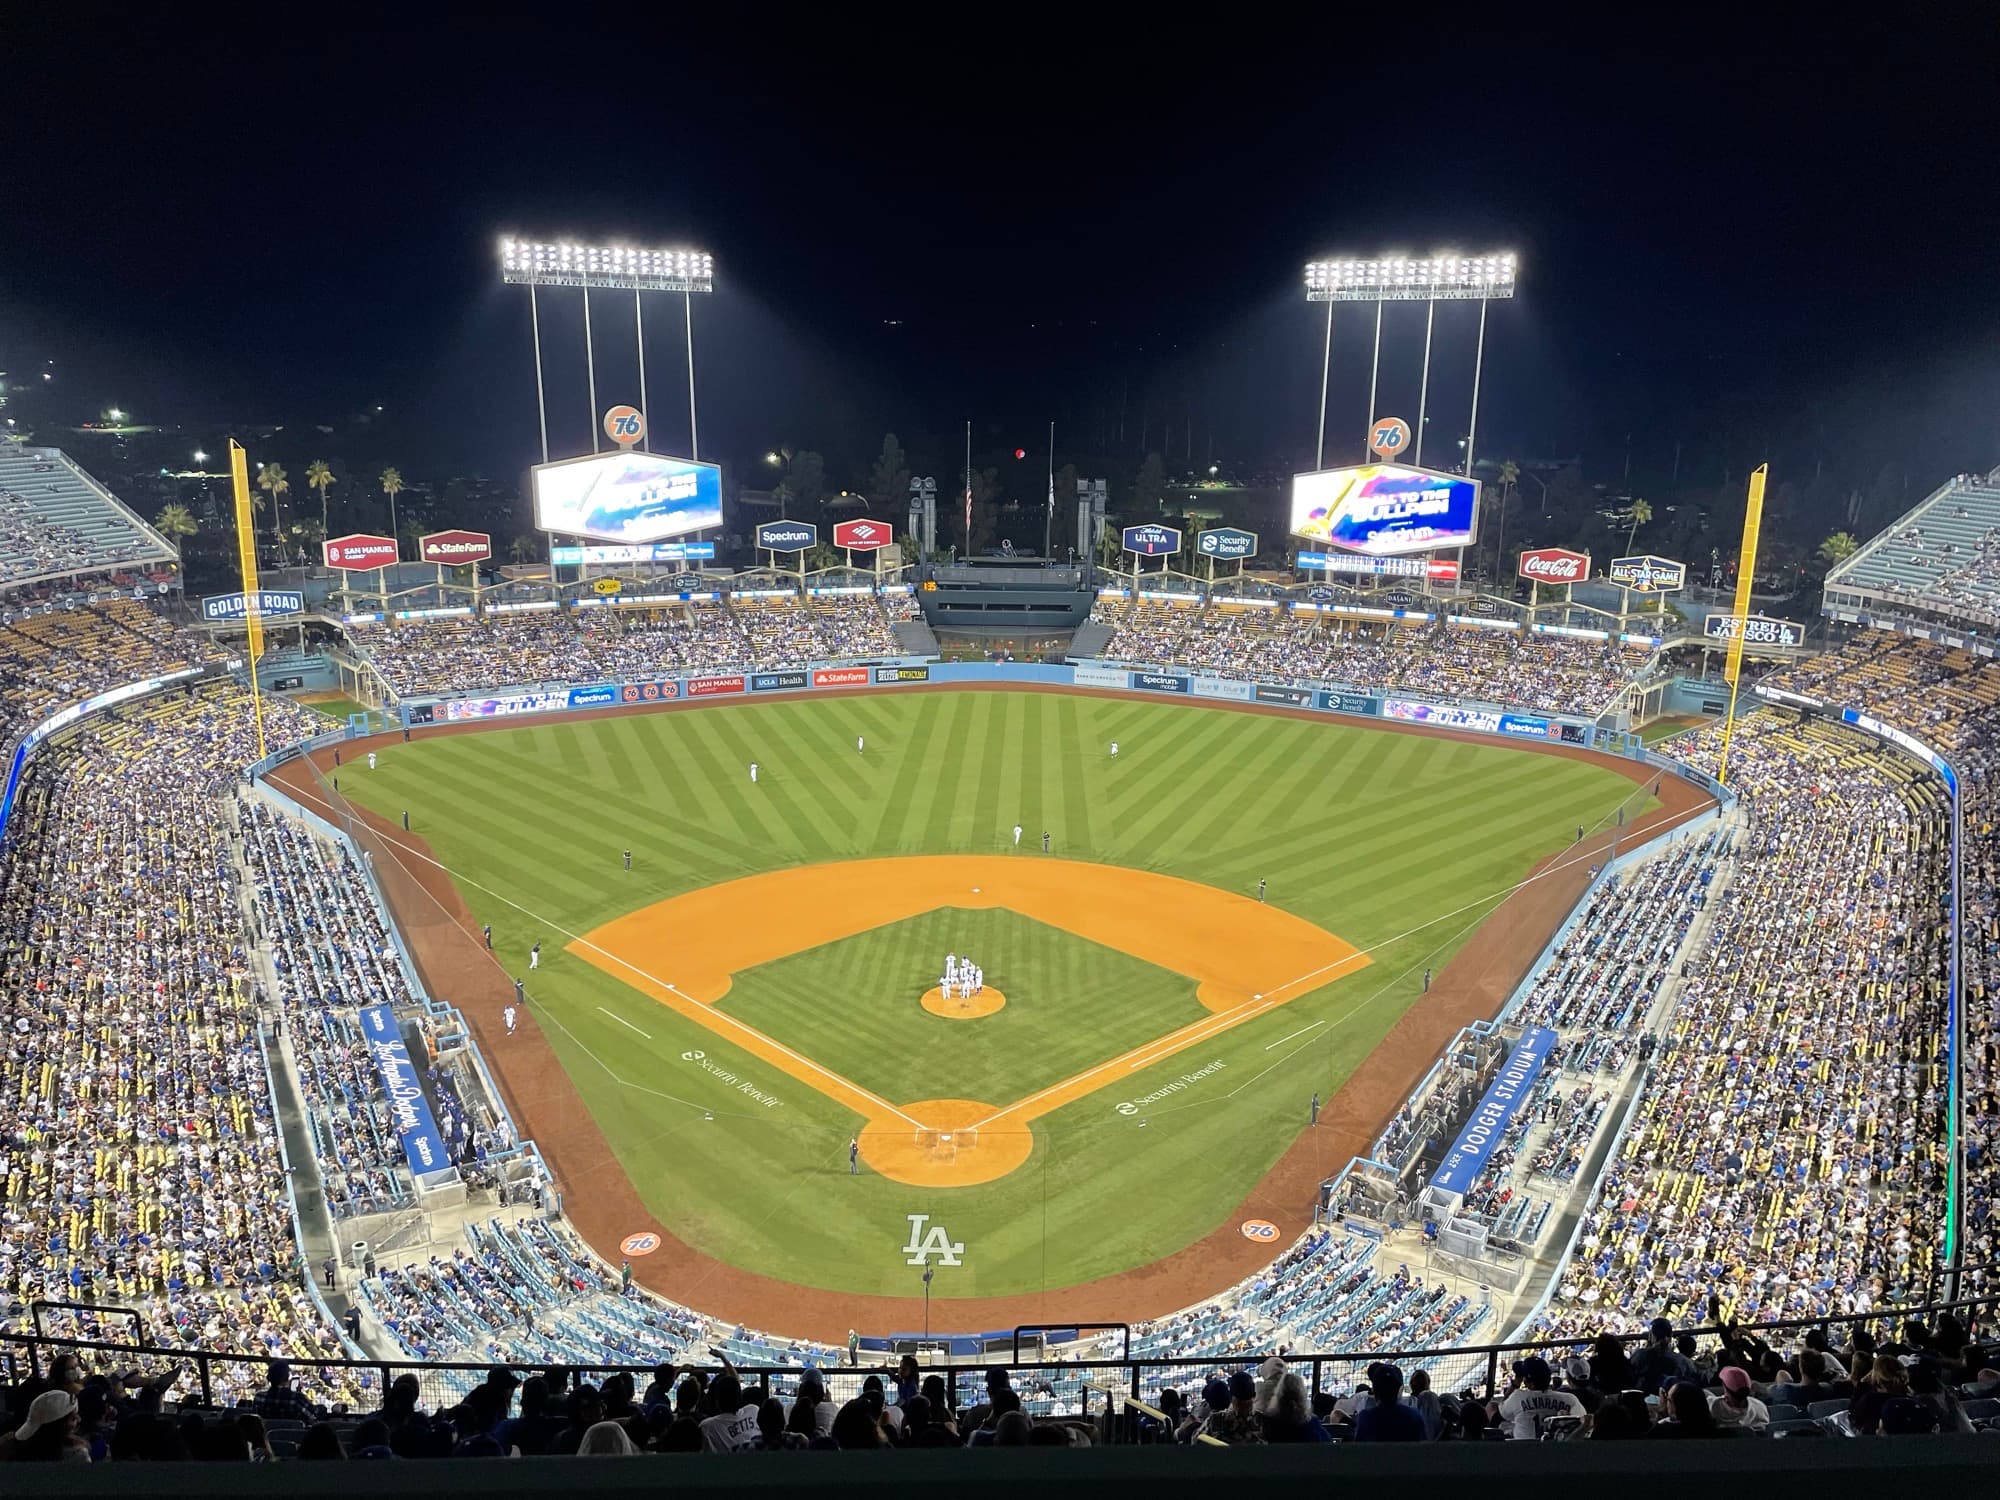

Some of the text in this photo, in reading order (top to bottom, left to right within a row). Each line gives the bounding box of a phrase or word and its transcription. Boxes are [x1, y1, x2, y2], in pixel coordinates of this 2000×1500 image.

[614, 414, 641, 436] 76
[1375, 425, 1403, 448] 76
[763, 531, 809, 543] Spectrum
[1135, 534, 1167, 543] ULTRA
[1220, 536, 1250, 546] Security
[344, 545, 394, 555] SAN MANUEL
[1220, 544, 1246, 553] Benefit
[1652, 571, 1679, 582] GAME
[264, 595, 298, 609] ROAD
[713, 679, 742, 687] MANUEL
[779, 677, 803, 685] Health
[1143, 675, 1177, 685] Spectrum
[647, 688, 656, 696] 76
[666, 686, 675, 694] 76
[574, 694, 611, 704] Spectrum
[1342, 696, 1367, 706] Security
[495, 698, 569, 715] BULLPEN
[1427, 712, 1499, 731] BULLPEN
[1505, 722, 1545, 735] Spectrum
[697, 1058, 780, 1107] Security Benefit
[1134, 1060, 1227, 1106] Security Benefit
[391, 1087, 422, 1128] Dodgers
[1460, 1051, 1537, 1155] DODGER STADIUM
[413, 1136, 433, 1166] Spectrum
[1249, 1224, 1275, 1238] 76
[627, 1235, 656, 1252] 76
[902, 1214, 964, 1266] LA
[1520, 1397, 1571, 1412] ALVARADO
[728, 1417, 755, 1438] BETTS
